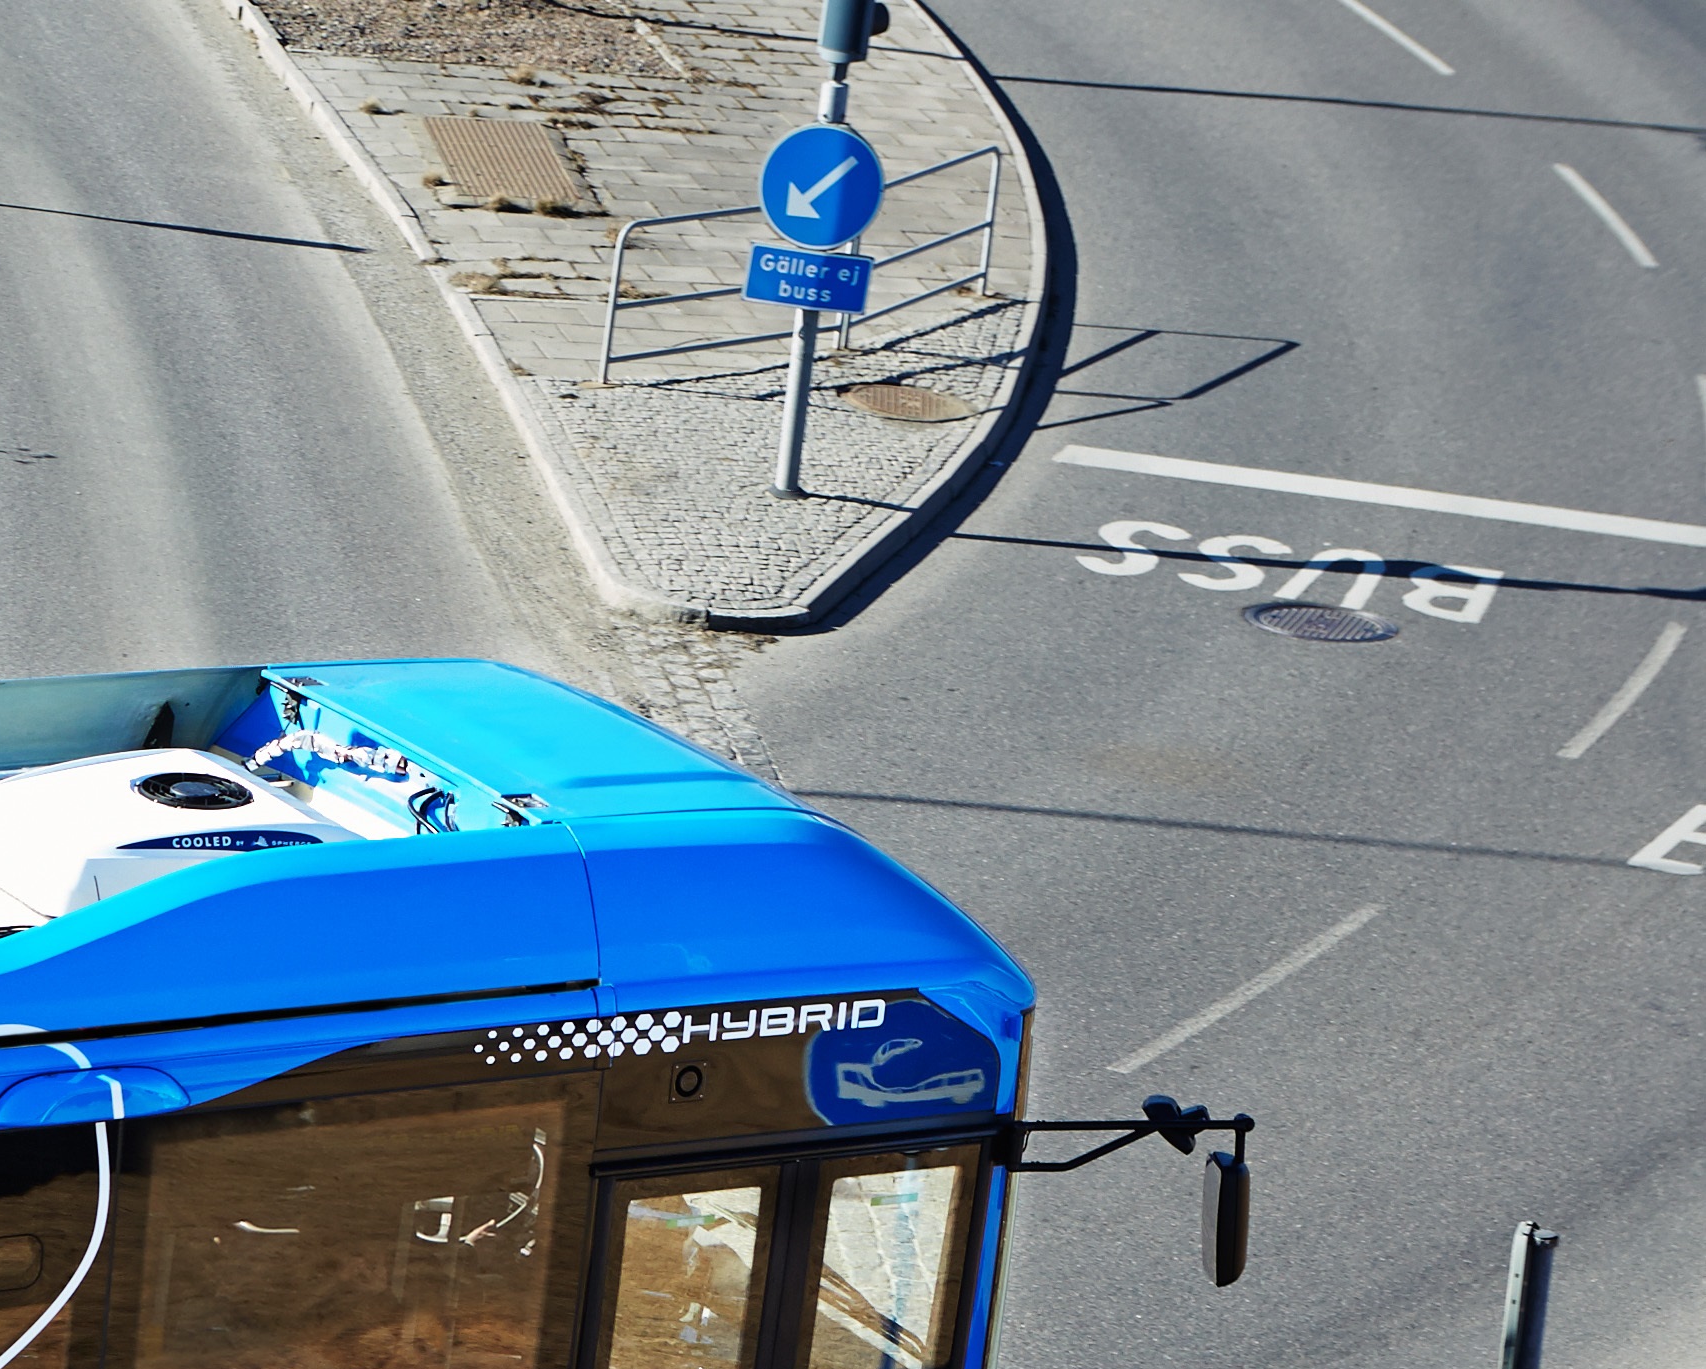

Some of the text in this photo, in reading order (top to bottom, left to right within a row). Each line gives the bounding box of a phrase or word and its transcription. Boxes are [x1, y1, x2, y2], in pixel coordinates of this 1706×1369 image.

[759, 253, 861, 286] Gäller ej
[778, 279, 832, 302] buss
[1074, 519, 1505, 624] BUSS
[172, 835, 232, 848] COOLED
[682, 998, 886, 1044] HYBRID
